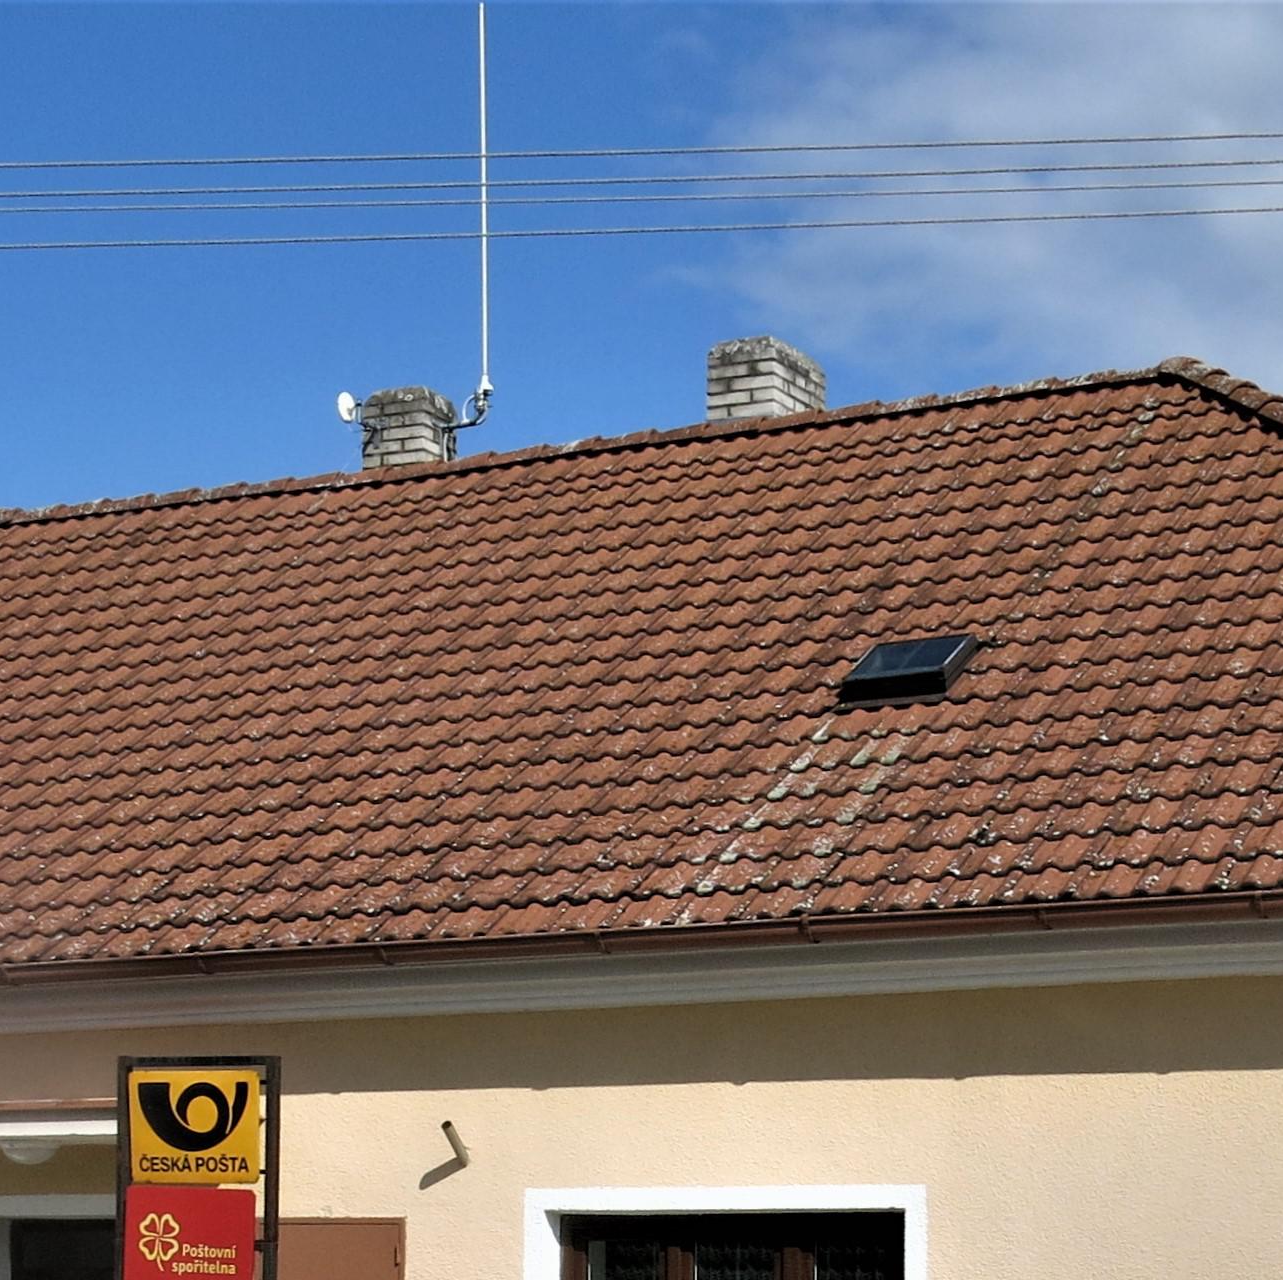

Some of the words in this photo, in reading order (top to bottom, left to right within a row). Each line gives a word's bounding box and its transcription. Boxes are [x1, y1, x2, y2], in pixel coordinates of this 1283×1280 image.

[139, 1154, 192, 1172] ČESKÁ
[195, 1154, 249, 1173] POŠTA
[182, 1244, 236, 1259] Poštovní
[171, 1260, 236, 1276] spořitelna
